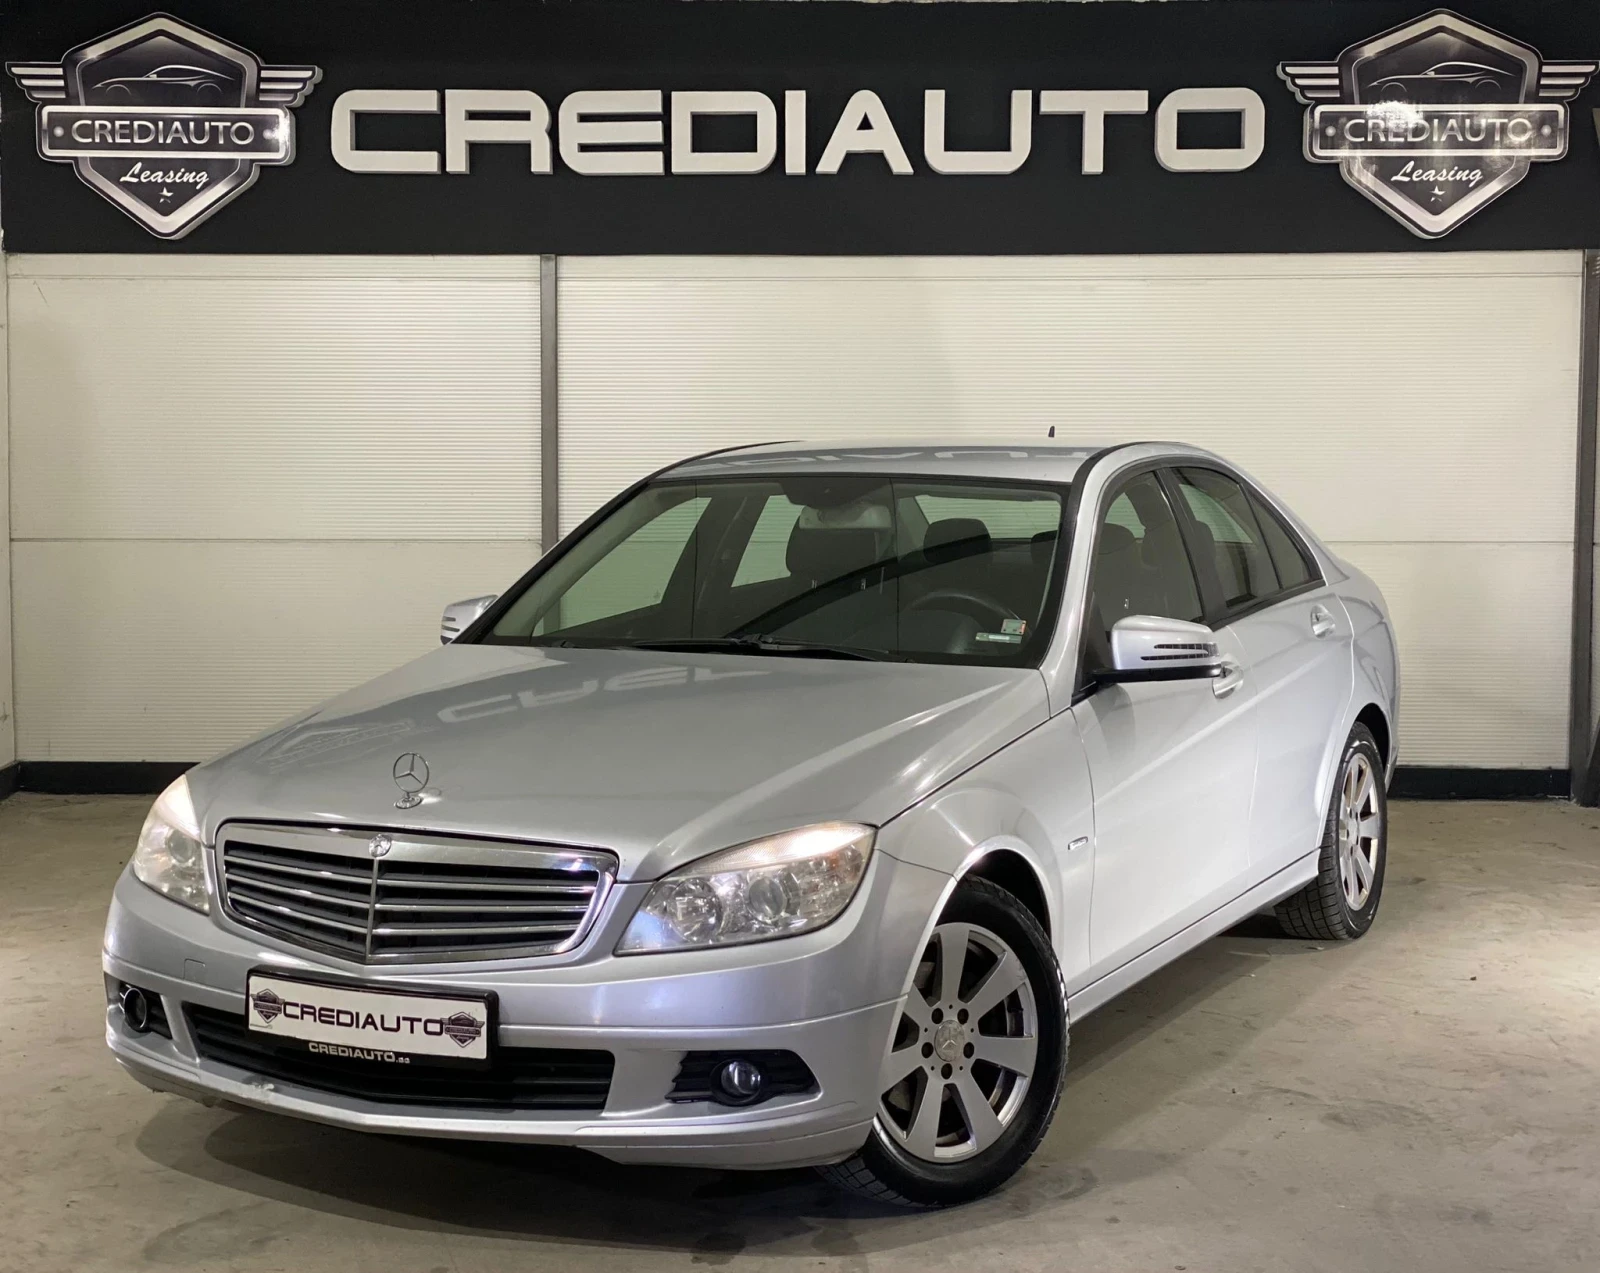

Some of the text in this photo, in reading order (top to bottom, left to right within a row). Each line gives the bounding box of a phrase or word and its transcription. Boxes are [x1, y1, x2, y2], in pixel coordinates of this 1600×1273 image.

[71, 120, 255, 145] CREDIAUTO
[332, 88, 1267, 175] CREDIAUTO
[1343, 118, 1533, 142] CREDIAUTO
[119, 161, 209, 190] Leasing
[1390, 160, 1483, 188] Leasing
[283, 1001, 445, 1036] CREDIAUTO
